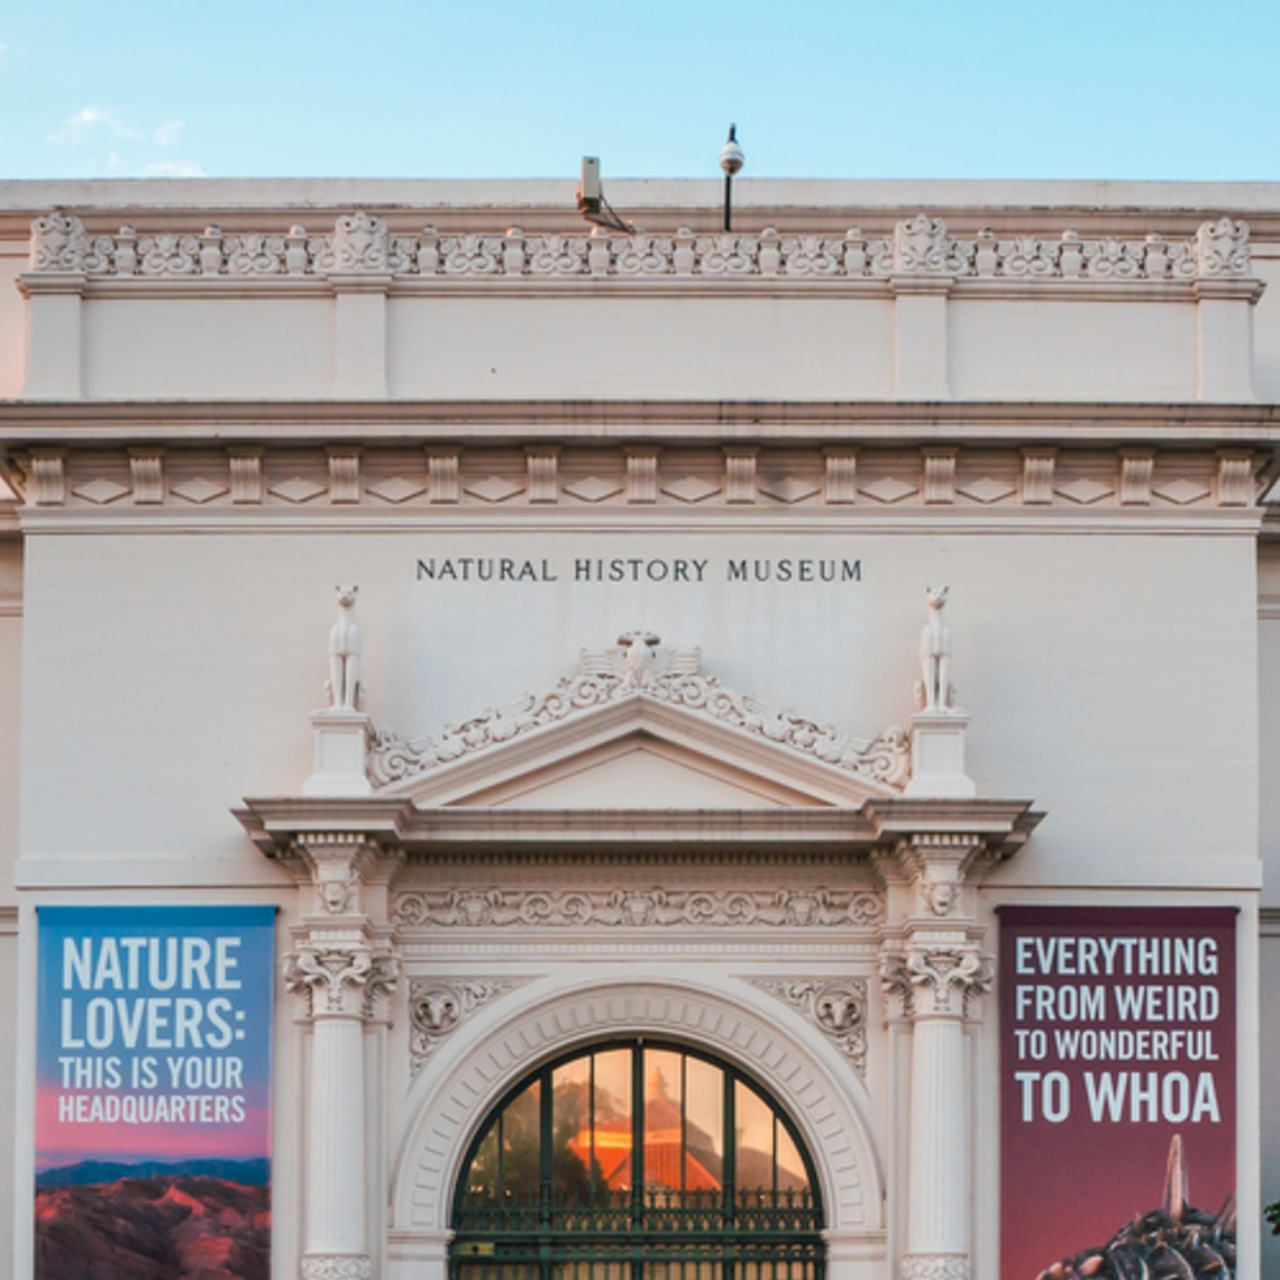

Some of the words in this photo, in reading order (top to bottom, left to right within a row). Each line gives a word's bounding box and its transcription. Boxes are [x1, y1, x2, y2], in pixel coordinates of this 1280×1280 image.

[416, 558, 558, 582] NATURAL
[574, 558, 709, 582] HISTORY
[726, 558, 863, 582] MUSEUM
[63, 936, 242, 990] NATURE
[1015, 936, 1218, 975] EVERYTHING
[1015, 985, 1105, 1021] FROM
[1114, 985, 1220, 1021] WEIRD
[61, 997, 246, 1049] LOVERS:
[1014, 1029, 1047, 1061] TO
[1054, 1029, 1220, 1061] WONDERFUL
[58, 1056, 122, 1090] THIS
[131, 1056, 159, 1090] IS
[166, 1056, 244, 1090] YOUR
[58, 1095, 246, 1124] HEADQUARTERS
[1014, 1071, 1070, 1123] TO
[1083, 1071, 1221, 1123] WHOA
